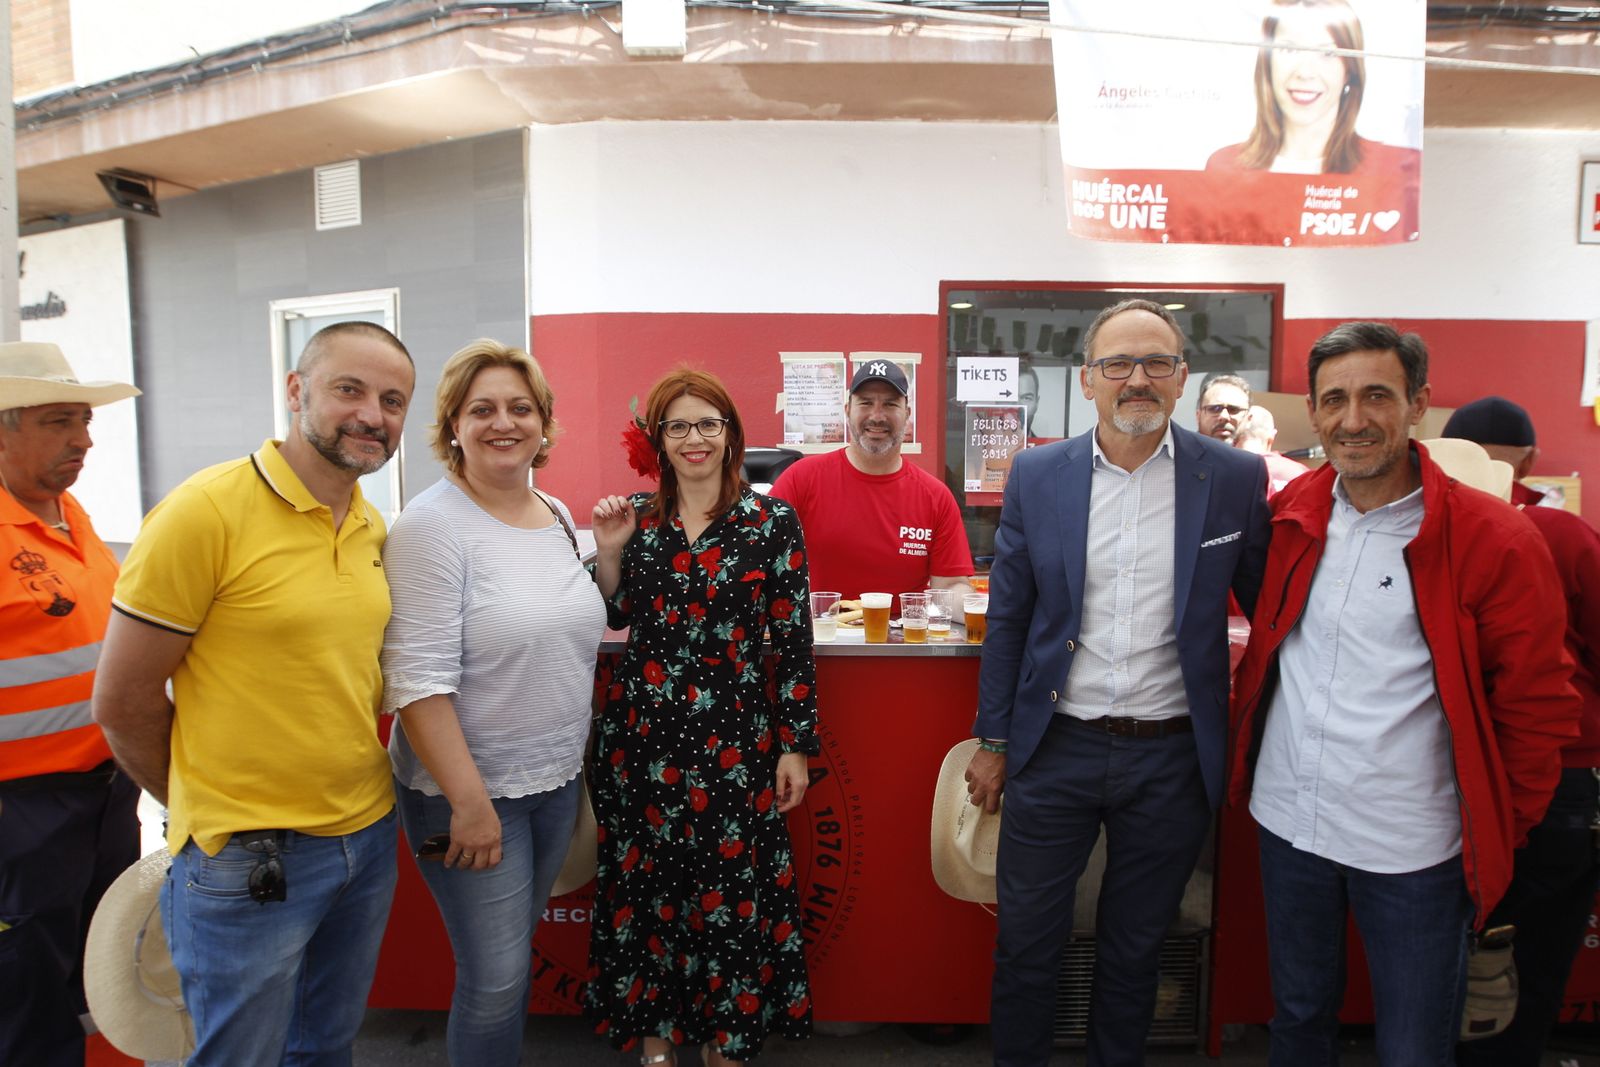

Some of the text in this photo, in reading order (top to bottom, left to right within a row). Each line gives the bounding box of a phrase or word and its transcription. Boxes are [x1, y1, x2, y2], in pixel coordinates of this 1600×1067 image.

[1097, 79, 1160, 101] Ángeles
[1072, 177, 1169, 204] HUÉRCAL
[1305, 184, 1359, 199] Huércal de
[1109, 204, 1167, 229] UNE
[1300, 211, 1357, 235] PSOE
[973, 418, 1018, 431] FELICES
[971, 434, 1019, 447] FIESTAS
[982, 448, 1008, 460] 2019
[900, 526, 932, 541] PSOE
[816, 805, 843, 868] 1876
